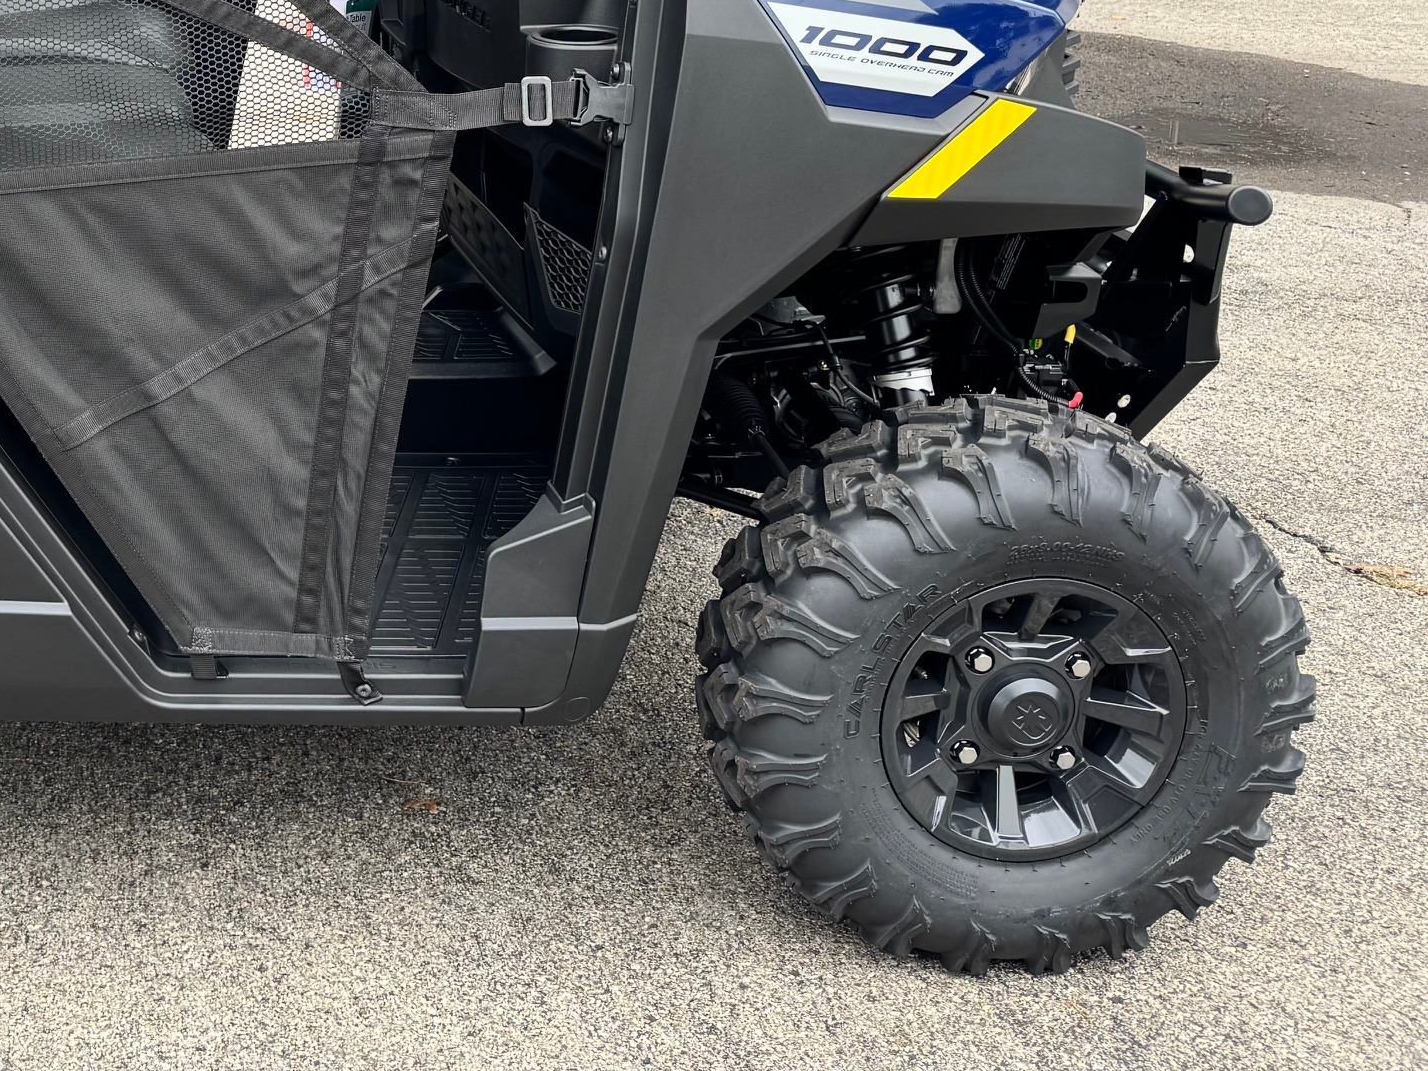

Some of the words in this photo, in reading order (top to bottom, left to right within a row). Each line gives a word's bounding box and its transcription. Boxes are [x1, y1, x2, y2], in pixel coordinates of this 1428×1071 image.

[800, 26, 968, 66] 1000
[810, 51, 857, 61] SINGLE
[860, 58, 925, 73] OVERHEAD
[927, 69, 954, 77] CAM
[844, 583, 942, 739] CARLSTAR
[1130, 821, 1154, 845] ONLY
